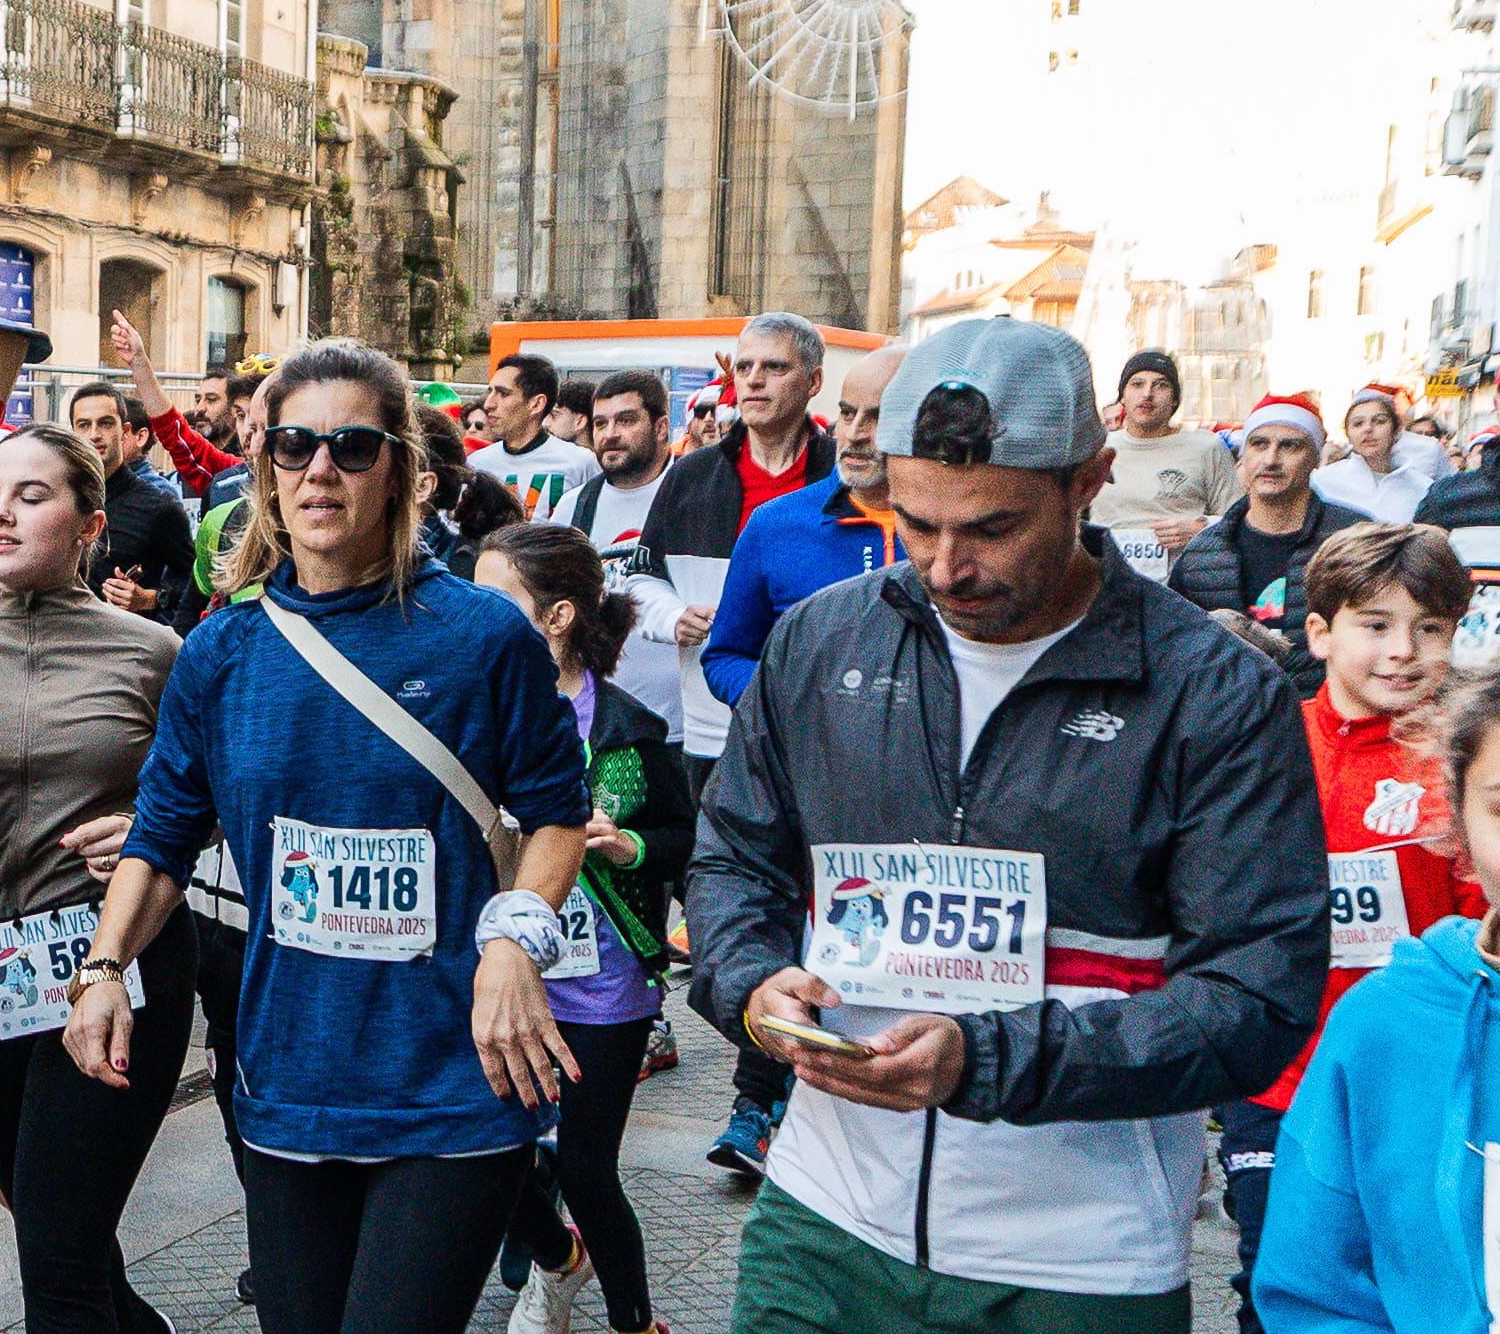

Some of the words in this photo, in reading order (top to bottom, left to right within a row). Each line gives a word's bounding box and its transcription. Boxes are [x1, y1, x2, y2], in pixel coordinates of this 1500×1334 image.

[309, 832, 336, 861] SAN
[342, 836, 426, 864] SILVESTRE
[327, 865, 418, 913] 1418
[872, 852, 918, 885] SAN
[925, 854, 1032, 894] SILVESTRE
[321, 911, 394, 936] PONTEVEDRA
[397, 917, 427, 936] 2025
[900, 890, 1027, 955] 6551
[570, 943, 592, 958] 2025
[885, 950, 985, 983] PONTEVEDRA
[990, 959, 1030, 986] 2025
